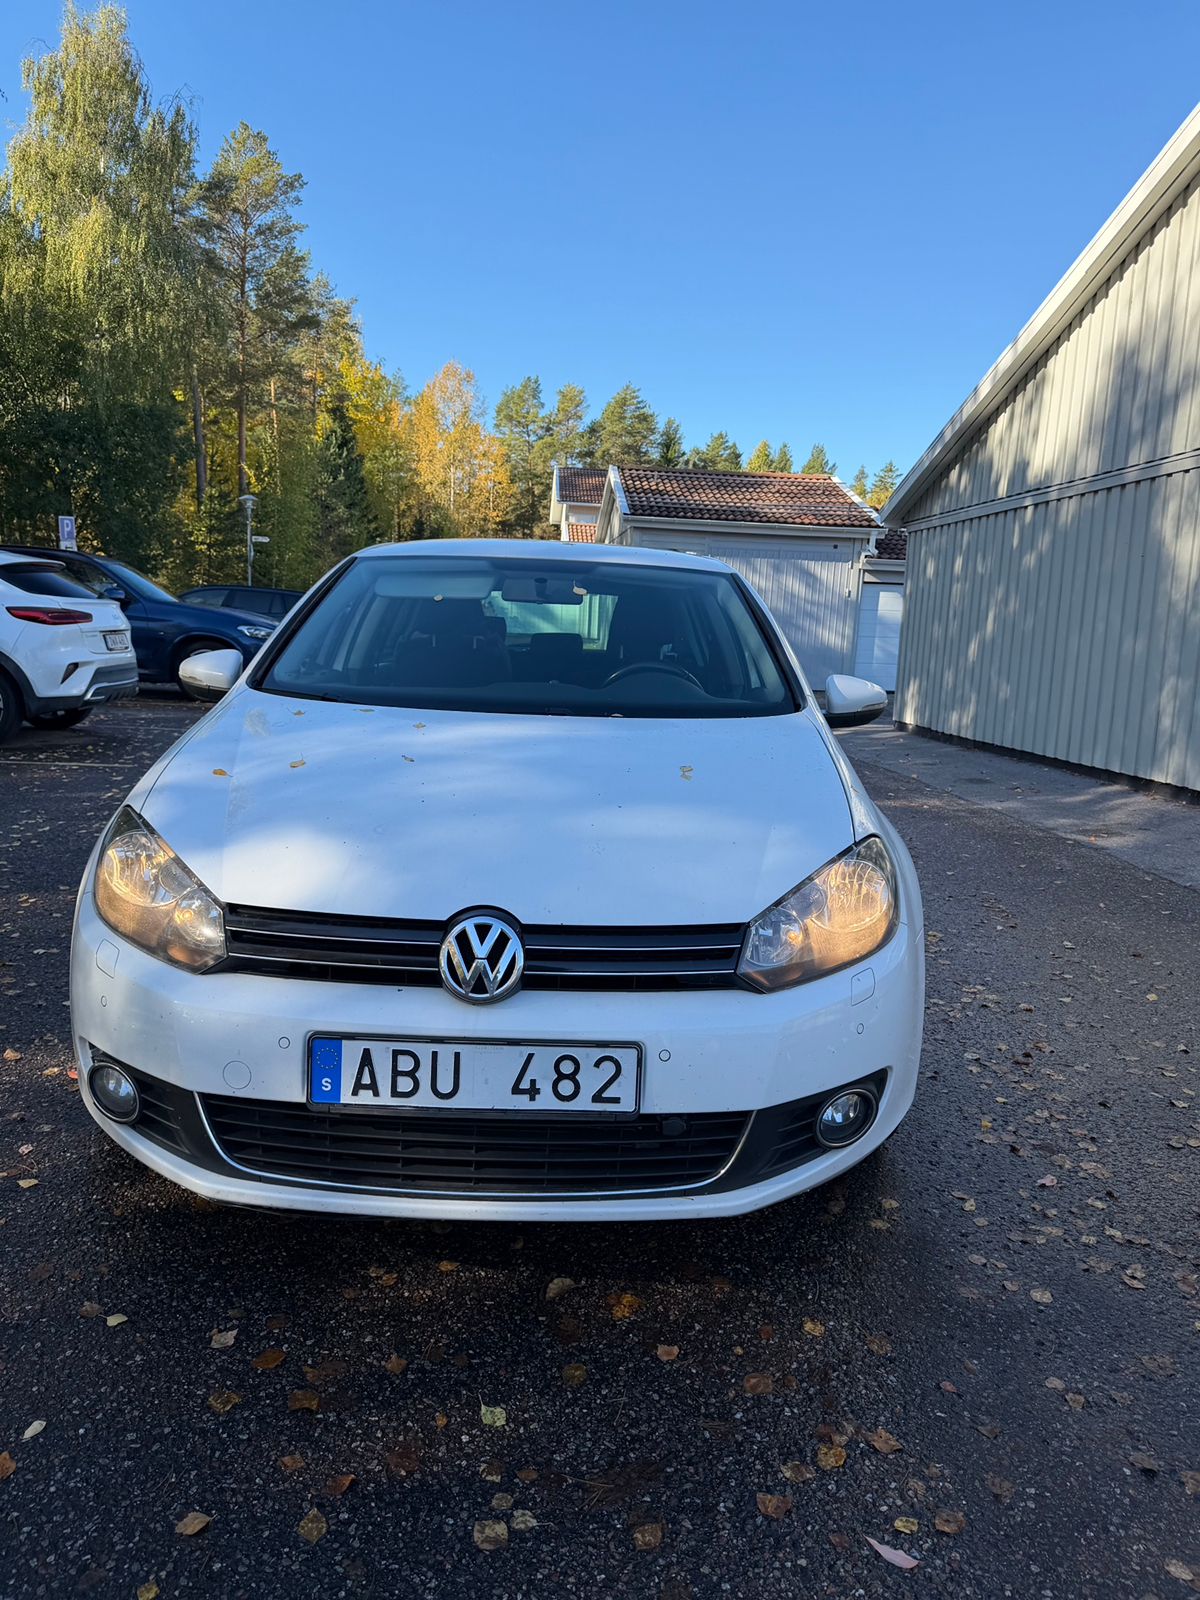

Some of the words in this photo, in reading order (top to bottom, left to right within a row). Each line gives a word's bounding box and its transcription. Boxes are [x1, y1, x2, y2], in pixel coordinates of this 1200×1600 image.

[64, 520, 72, 539] P
[442, 917, 522, 1002] VW
[321, 1078, 333, 1092] S
[351, 1047, 461, 1100] ABU
[511, 1052, 622, 1104] 482
